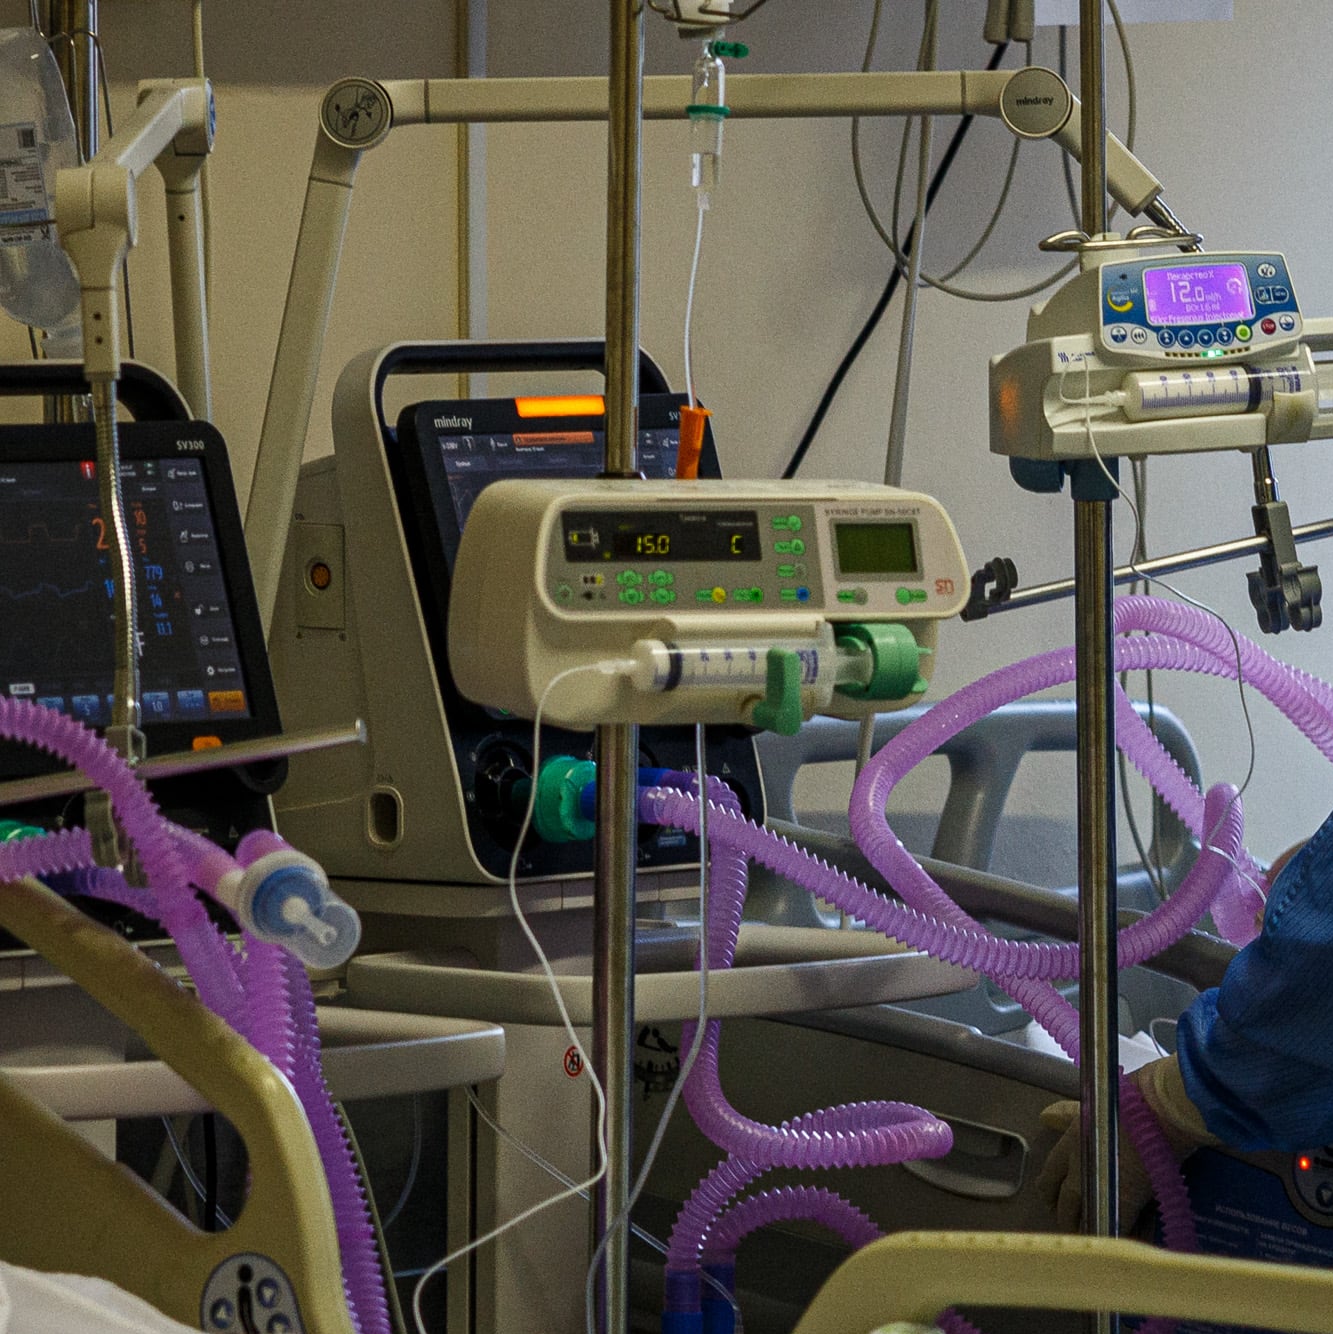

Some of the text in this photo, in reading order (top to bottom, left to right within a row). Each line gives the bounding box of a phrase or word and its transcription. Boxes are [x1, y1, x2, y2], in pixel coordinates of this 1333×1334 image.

[1016, 96, 1053, 106] mindray
[434, 416, 472, 430] mindray
[177, 440, 204, 450] SV300
[636, 535, 670, 554] 15.0
